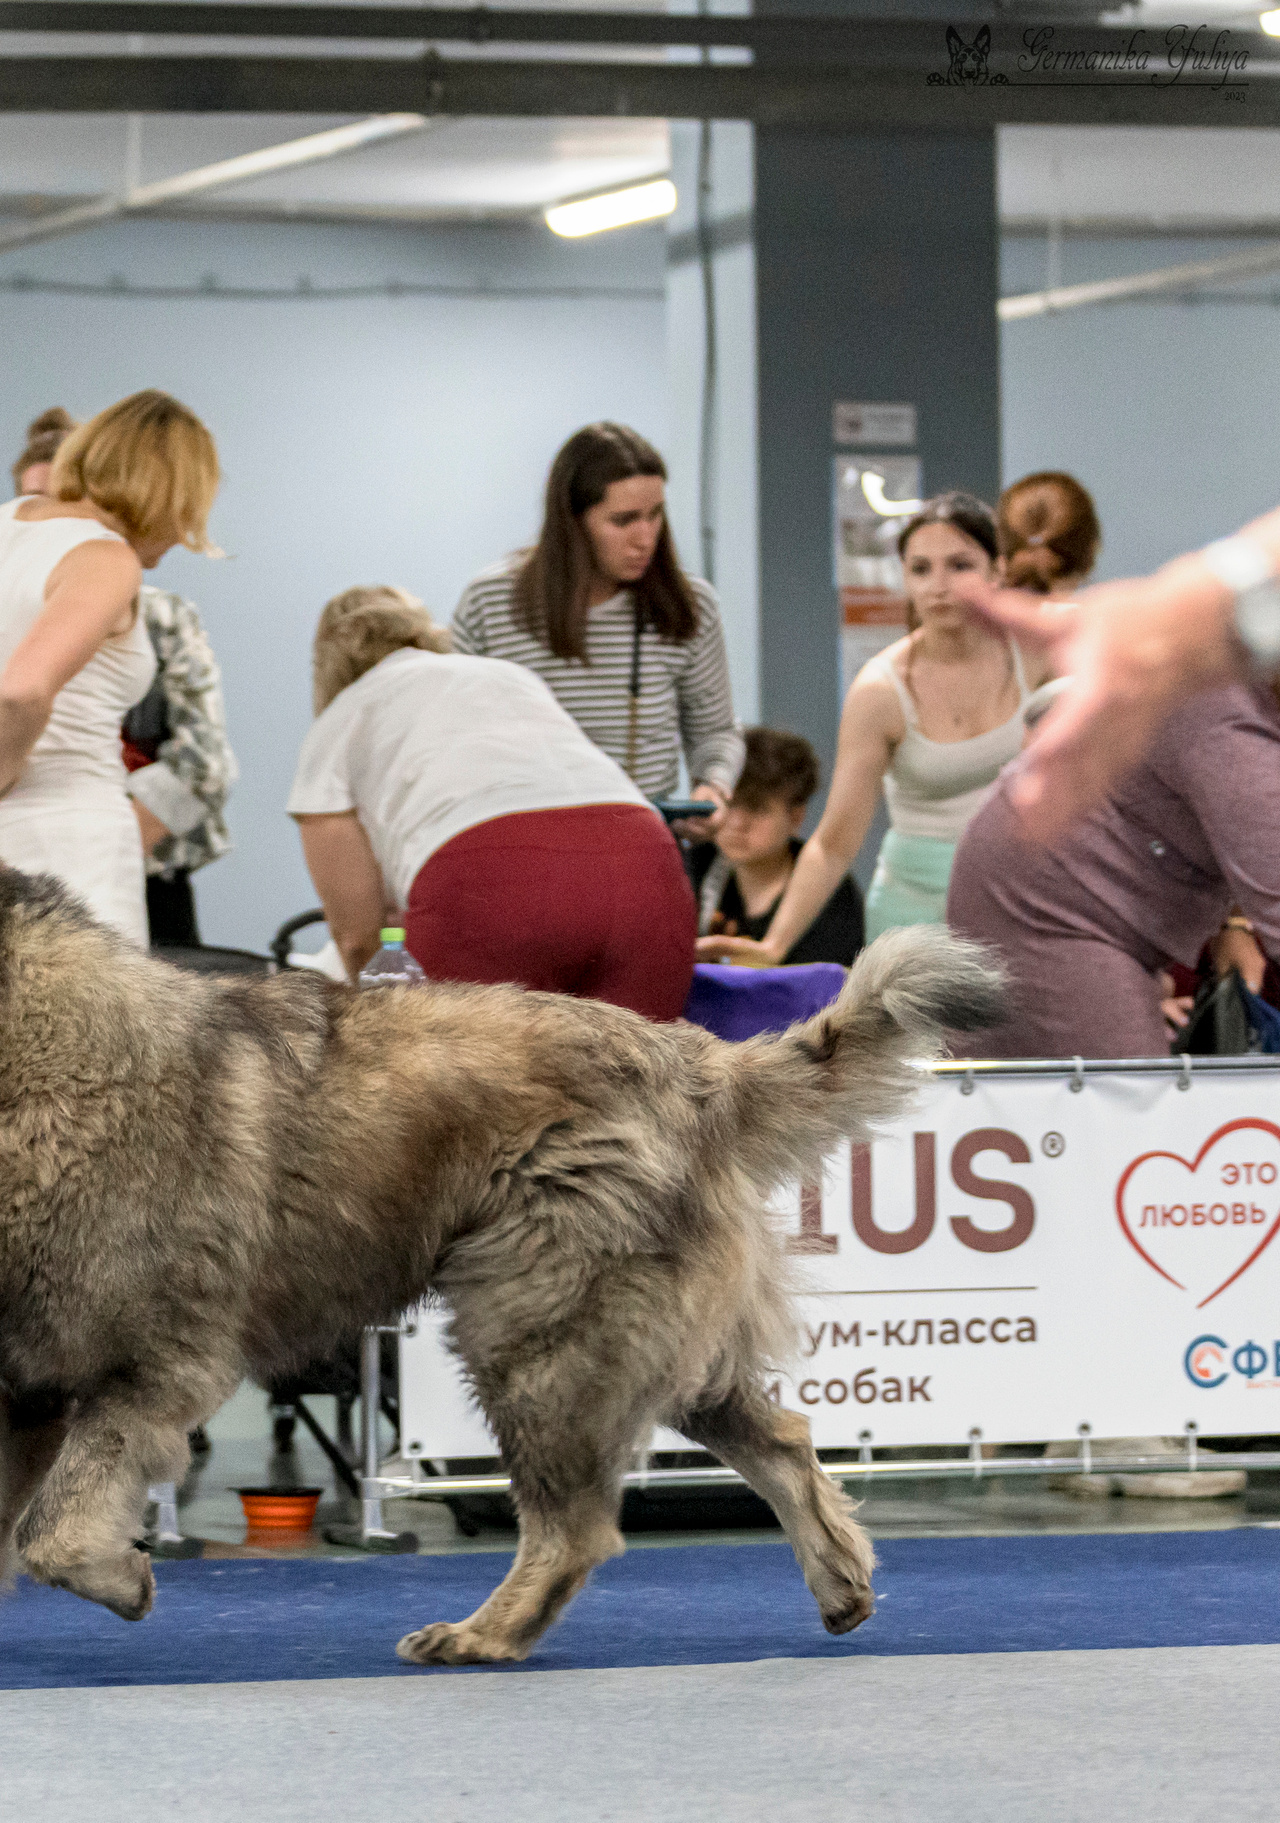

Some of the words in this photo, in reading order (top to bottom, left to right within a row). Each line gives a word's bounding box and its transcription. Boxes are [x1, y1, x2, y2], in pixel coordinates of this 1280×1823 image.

[1221, 1162, 1278, 1186] ЭТО
[1138, 1201, 1267, 1228] ЛЮБОВЬ
[1183, 1333, 1280, 1389] СФ
[798, 1367, 933, 1406] собак
